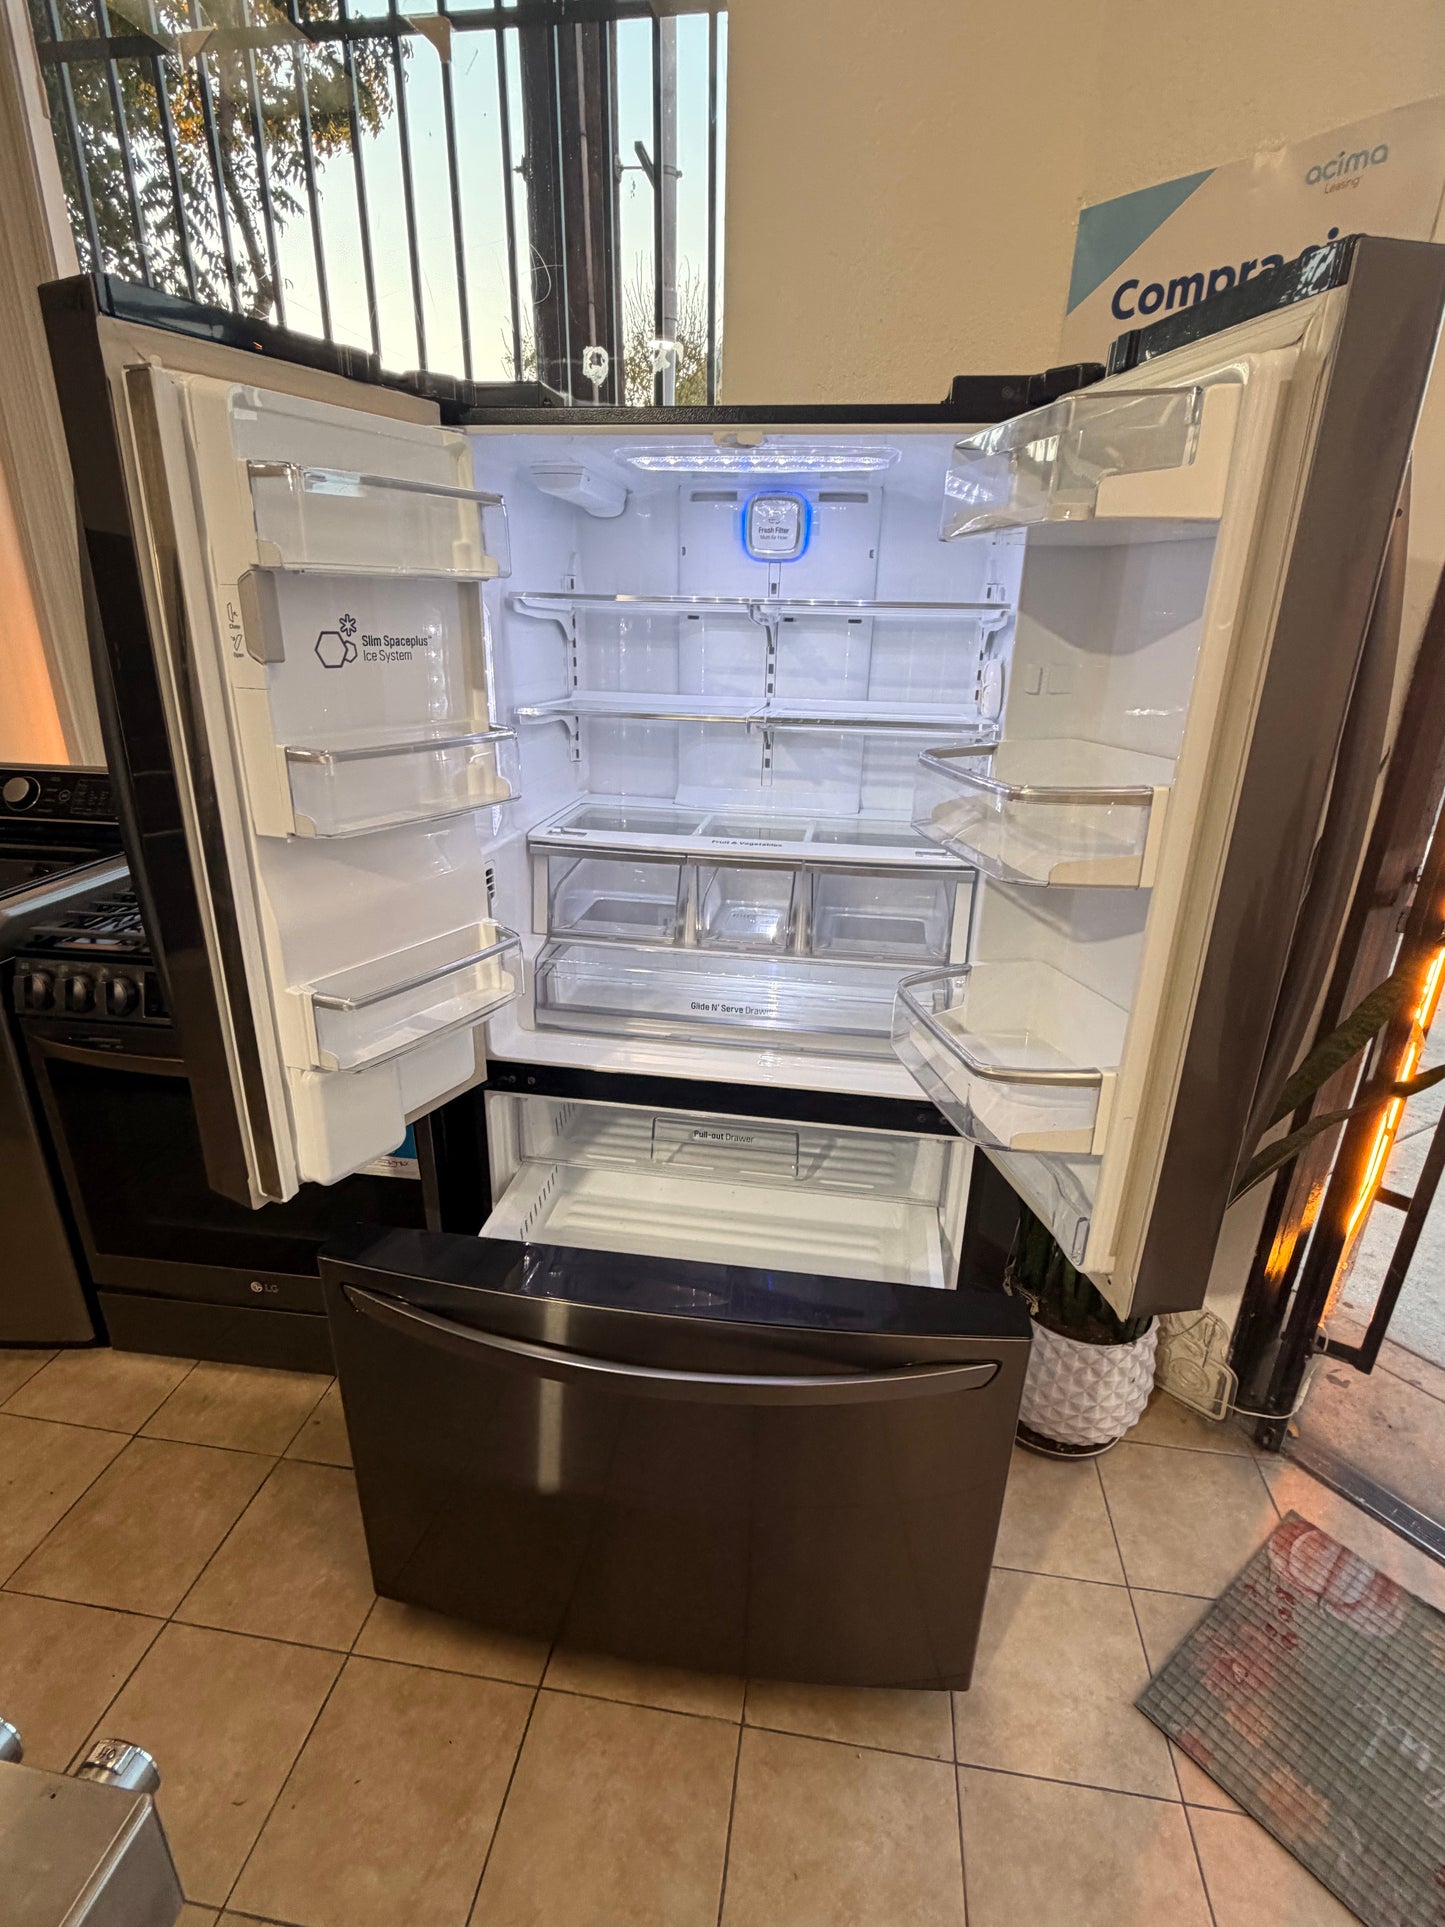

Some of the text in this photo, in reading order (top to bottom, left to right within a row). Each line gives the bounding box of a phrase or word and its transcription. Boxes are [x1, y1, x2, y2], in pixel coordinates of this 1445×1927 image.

[1305, 143, 1389, 186] acima
[758, 526, 790, 534] Fresh Filter
[361, 634, 382, 647] Slim
[363, 649, 413, 663] Ice System
[690, 1001, 710, 1011] Glide
[720, 1004, 744, 1014] Serve
[693, 1129, 754, 1143] Pull-out Drawer
[264, 1283, 280, 1293] LG
